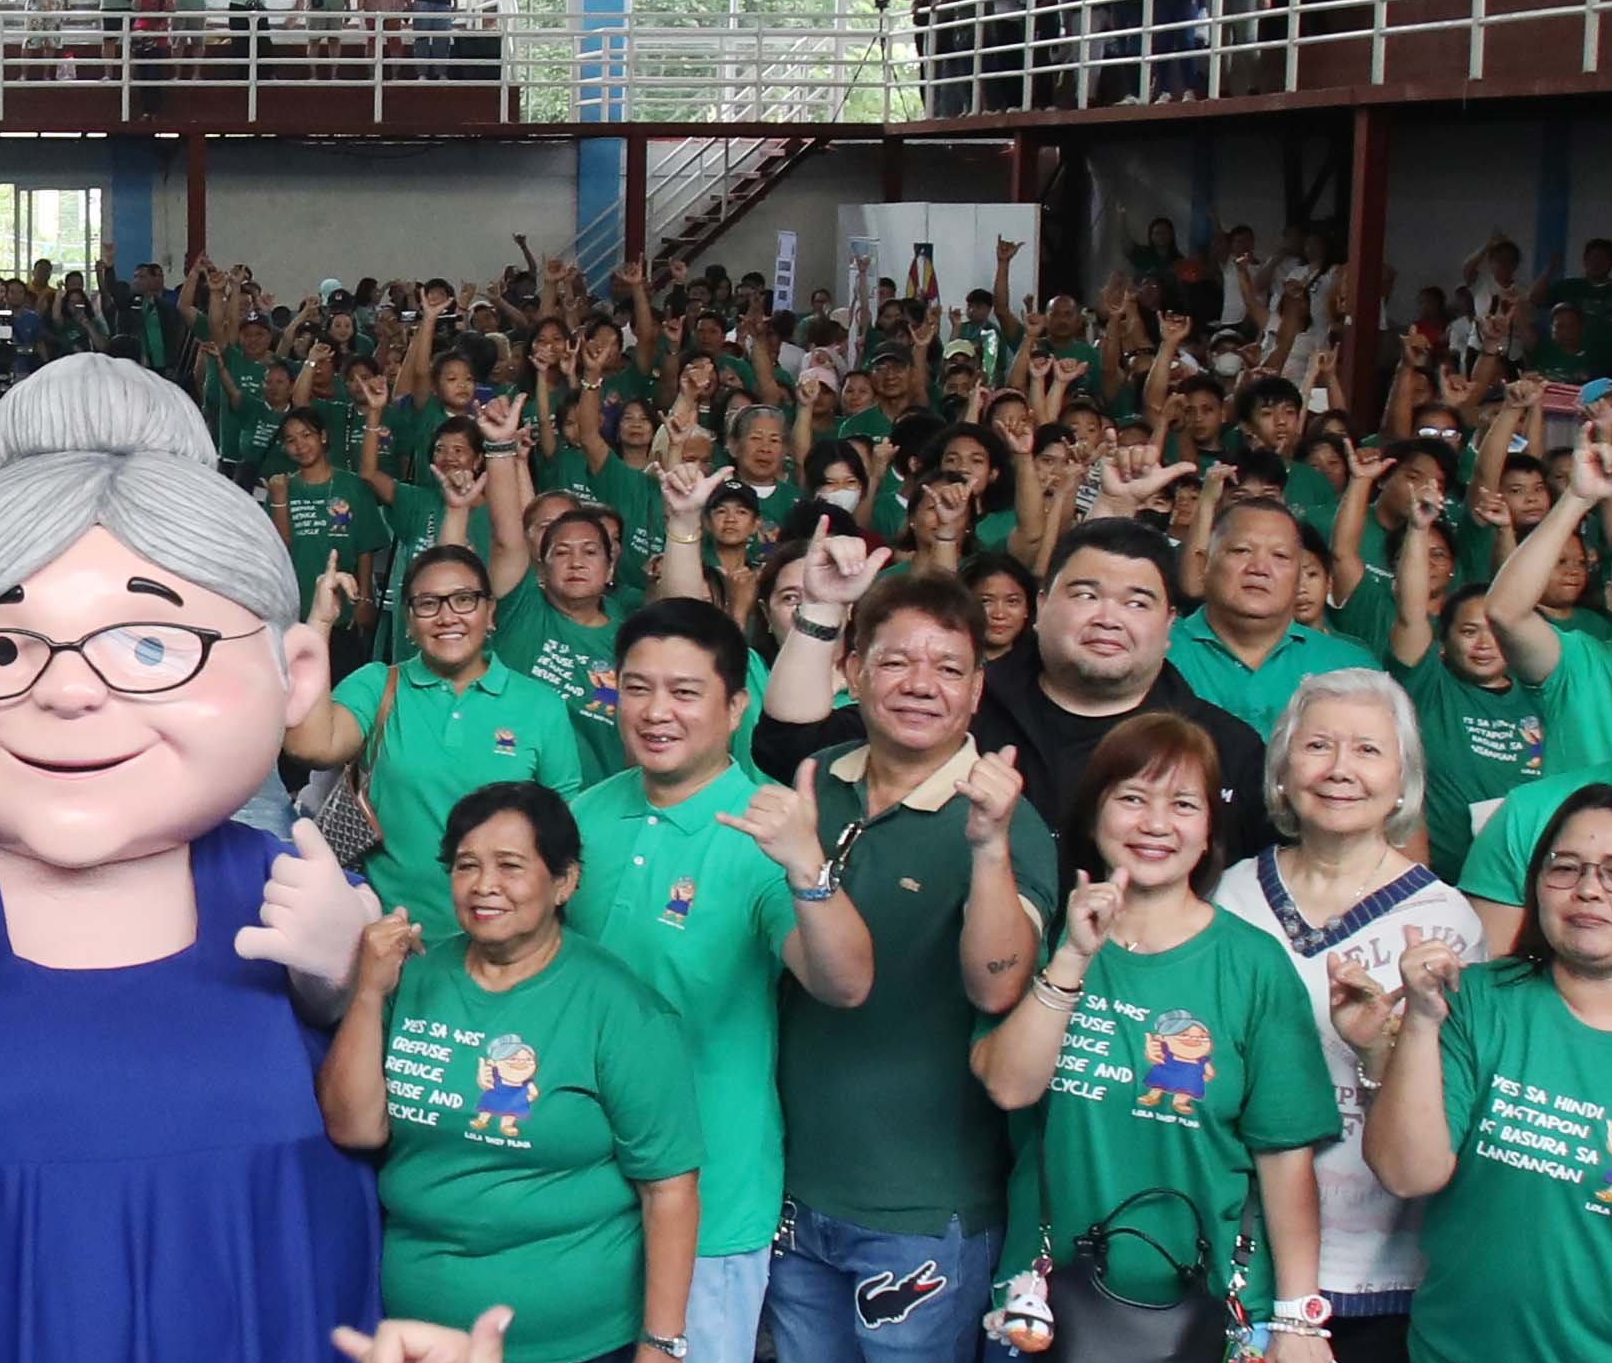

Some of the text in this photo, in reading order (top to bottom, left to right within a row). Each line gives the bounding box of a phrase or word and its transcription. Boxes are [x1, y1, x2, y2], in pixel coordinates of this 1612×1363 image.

[1086, 995, 1108, 1011] SA
[402, 1018, 426, 1034] YES
[429, 1022, 448, 1038] SA
[1094, 1063, 1133, 1083] AND
[428, 1089, 463, 1109] AND
[1491, 1074, 1605, 1120] YES SA HINDI
[387, 1102, 440, 1126] ECYCLE
[1492, 1098, 1590, 1139] PAGTAPON
[1500, 1125, 1569, 1157] BASURA
[1575, 1147, 1599, 1165] SA
[1476, 1140, 1583, 1184] LANSANGAN
